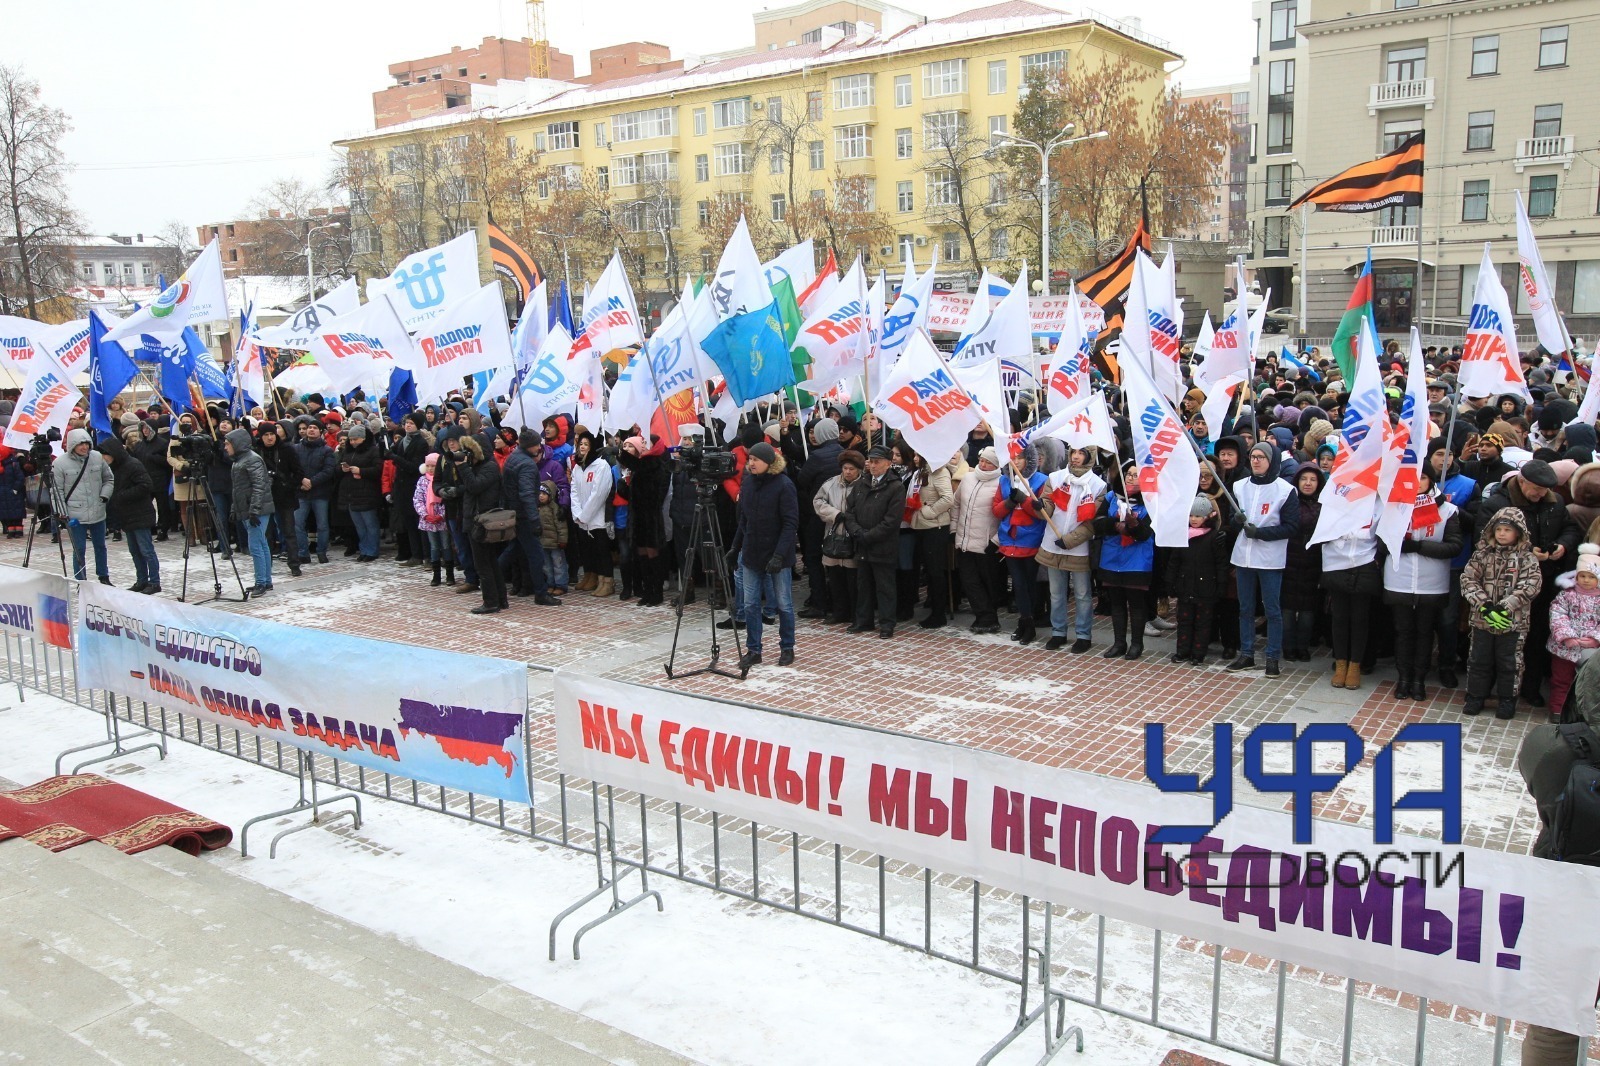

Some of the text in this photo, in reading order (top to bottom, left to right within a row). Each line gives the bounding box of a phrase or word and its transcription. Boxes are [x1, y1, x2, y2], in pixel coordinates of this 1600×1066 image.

[154, 623, 262, 677] ЕДИНСТВО
[147, 663, 201, 707] НАША
[200, 685, 287, 731] ОБЩАЯ
[292, 707, 401, 762] ЗАДАЧА
[577, 699, 1526, 971] МЫ ЕДИНЫ! МЫ НЕПОБЕДИМЫ!
